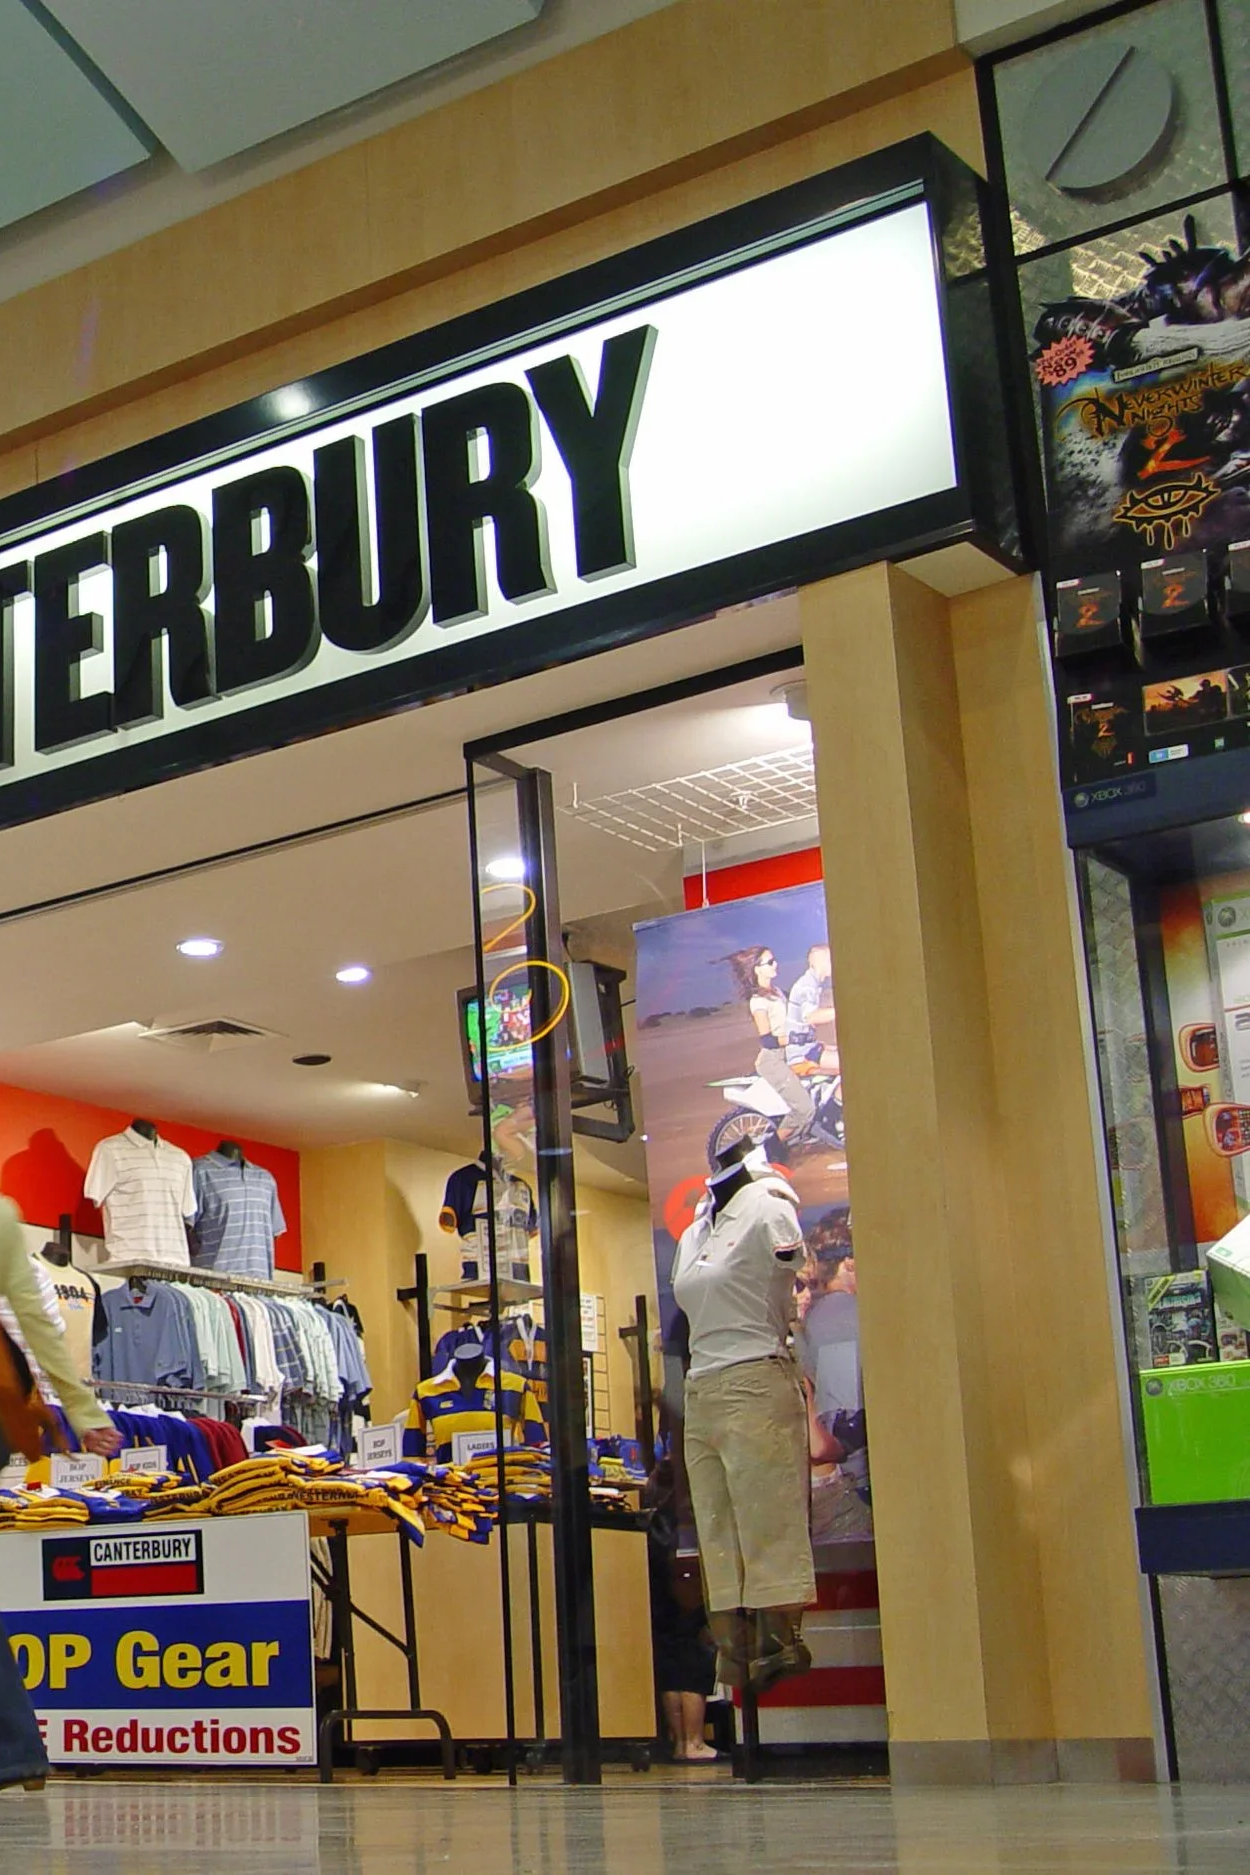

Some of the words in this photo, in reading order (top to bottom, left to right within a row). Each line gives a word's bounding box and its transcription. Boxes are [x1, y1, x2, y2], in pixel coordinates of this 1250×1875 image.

[93, 1536, 192, 1563] CANTERBURY
[8, 1631, 92, 1691] OP
[115, 1630, 280, 1690] Gear
[64, 1718, 301, 1754] Reductions
